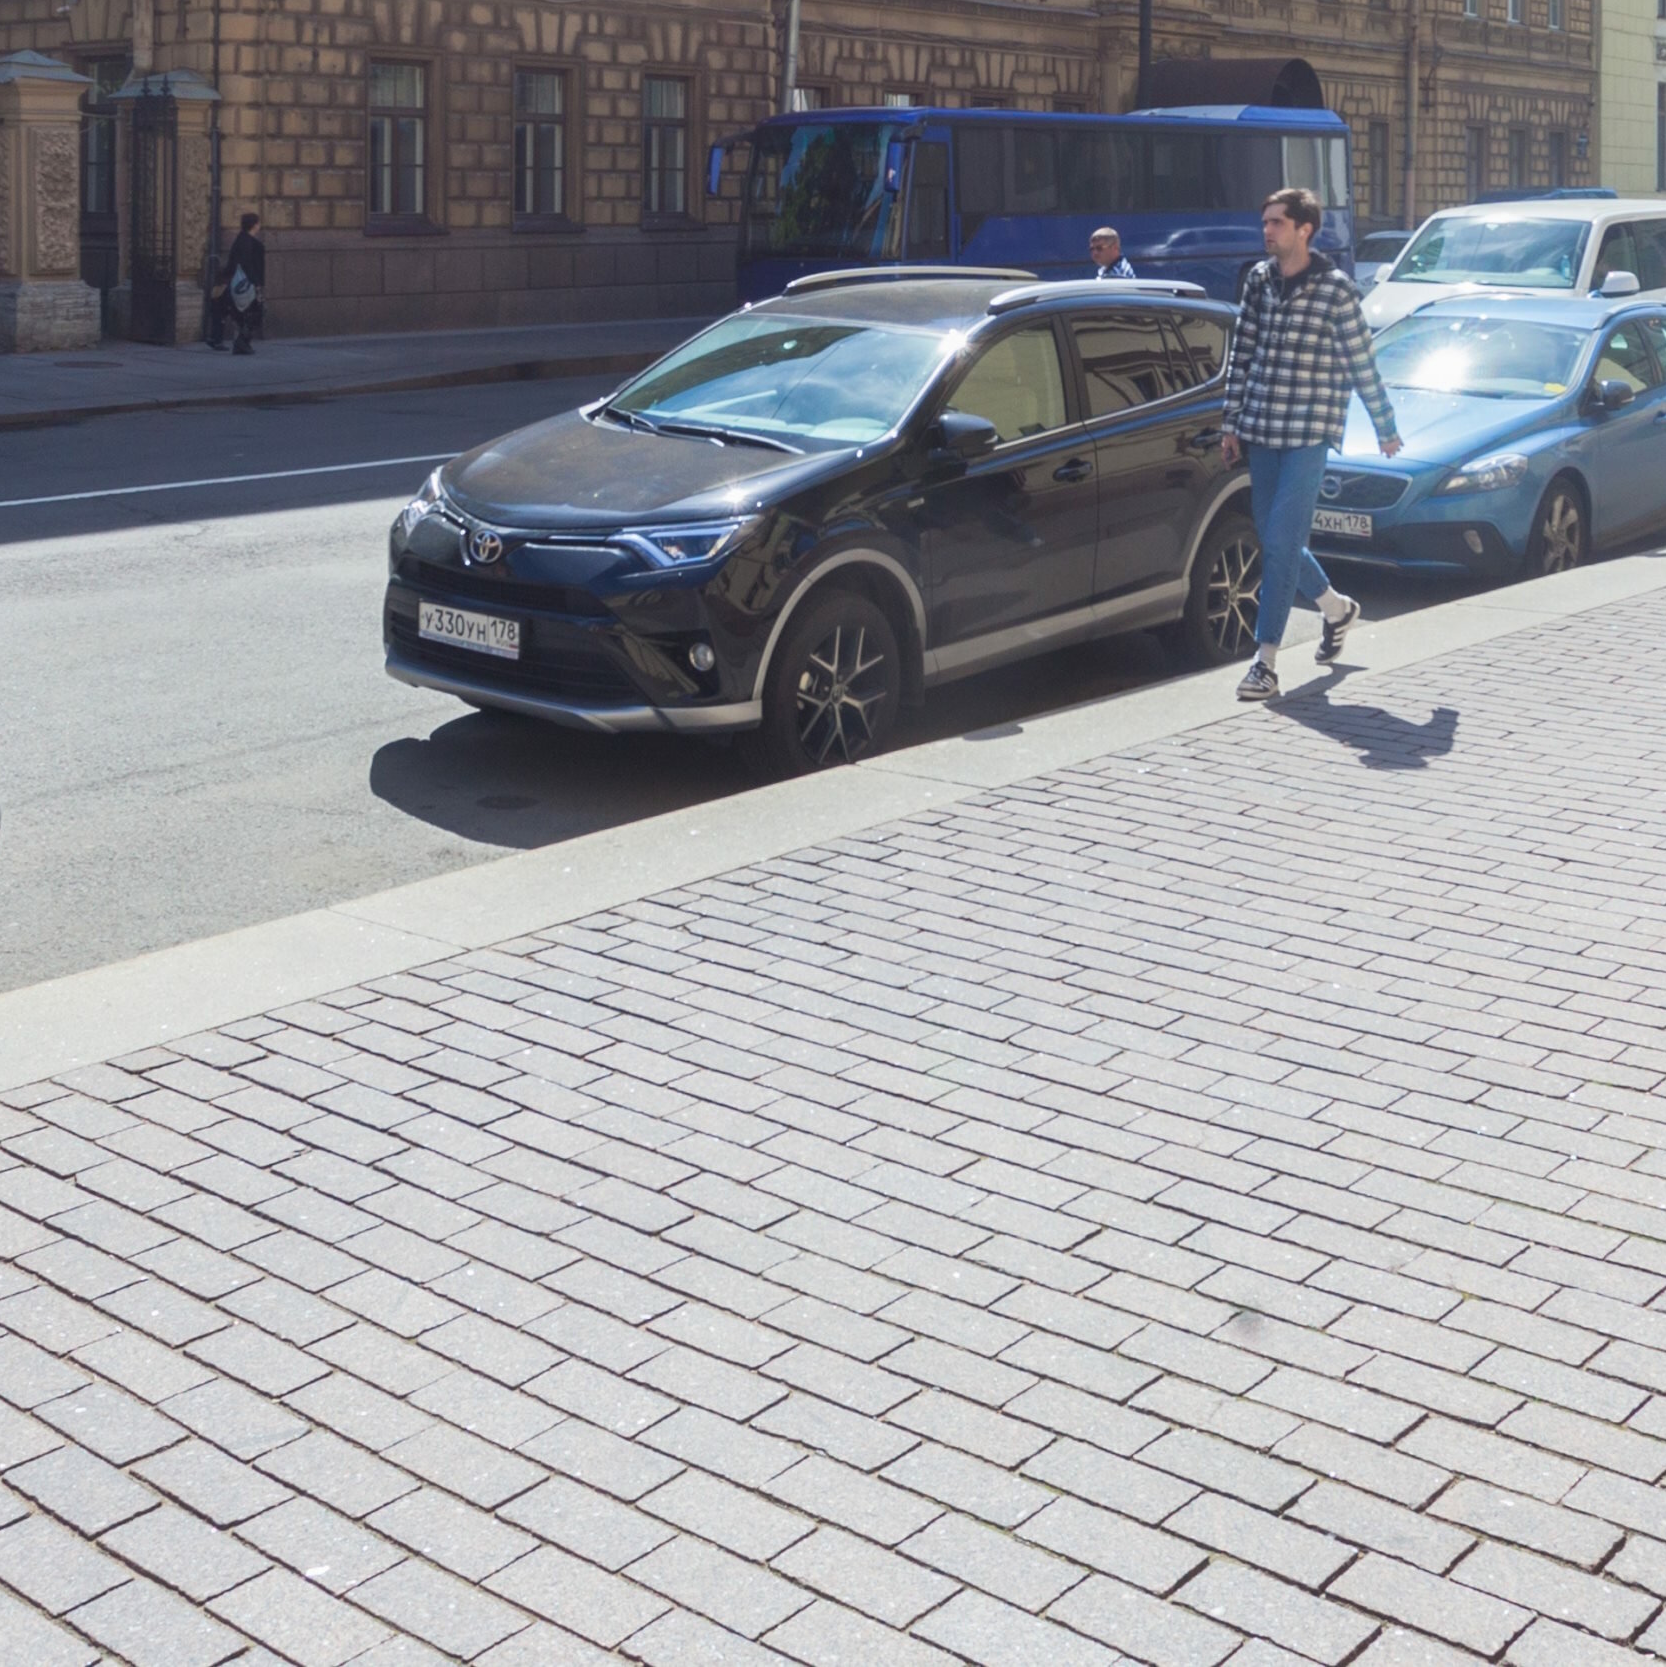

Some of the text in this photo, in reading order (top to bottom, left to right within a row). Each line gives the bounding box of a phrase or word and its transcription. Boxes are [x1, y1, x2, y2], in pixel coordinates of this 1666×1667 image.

[1314, 512, 1342, 530] 4ХН
[424, 608, 516, 643] У330УН 178
